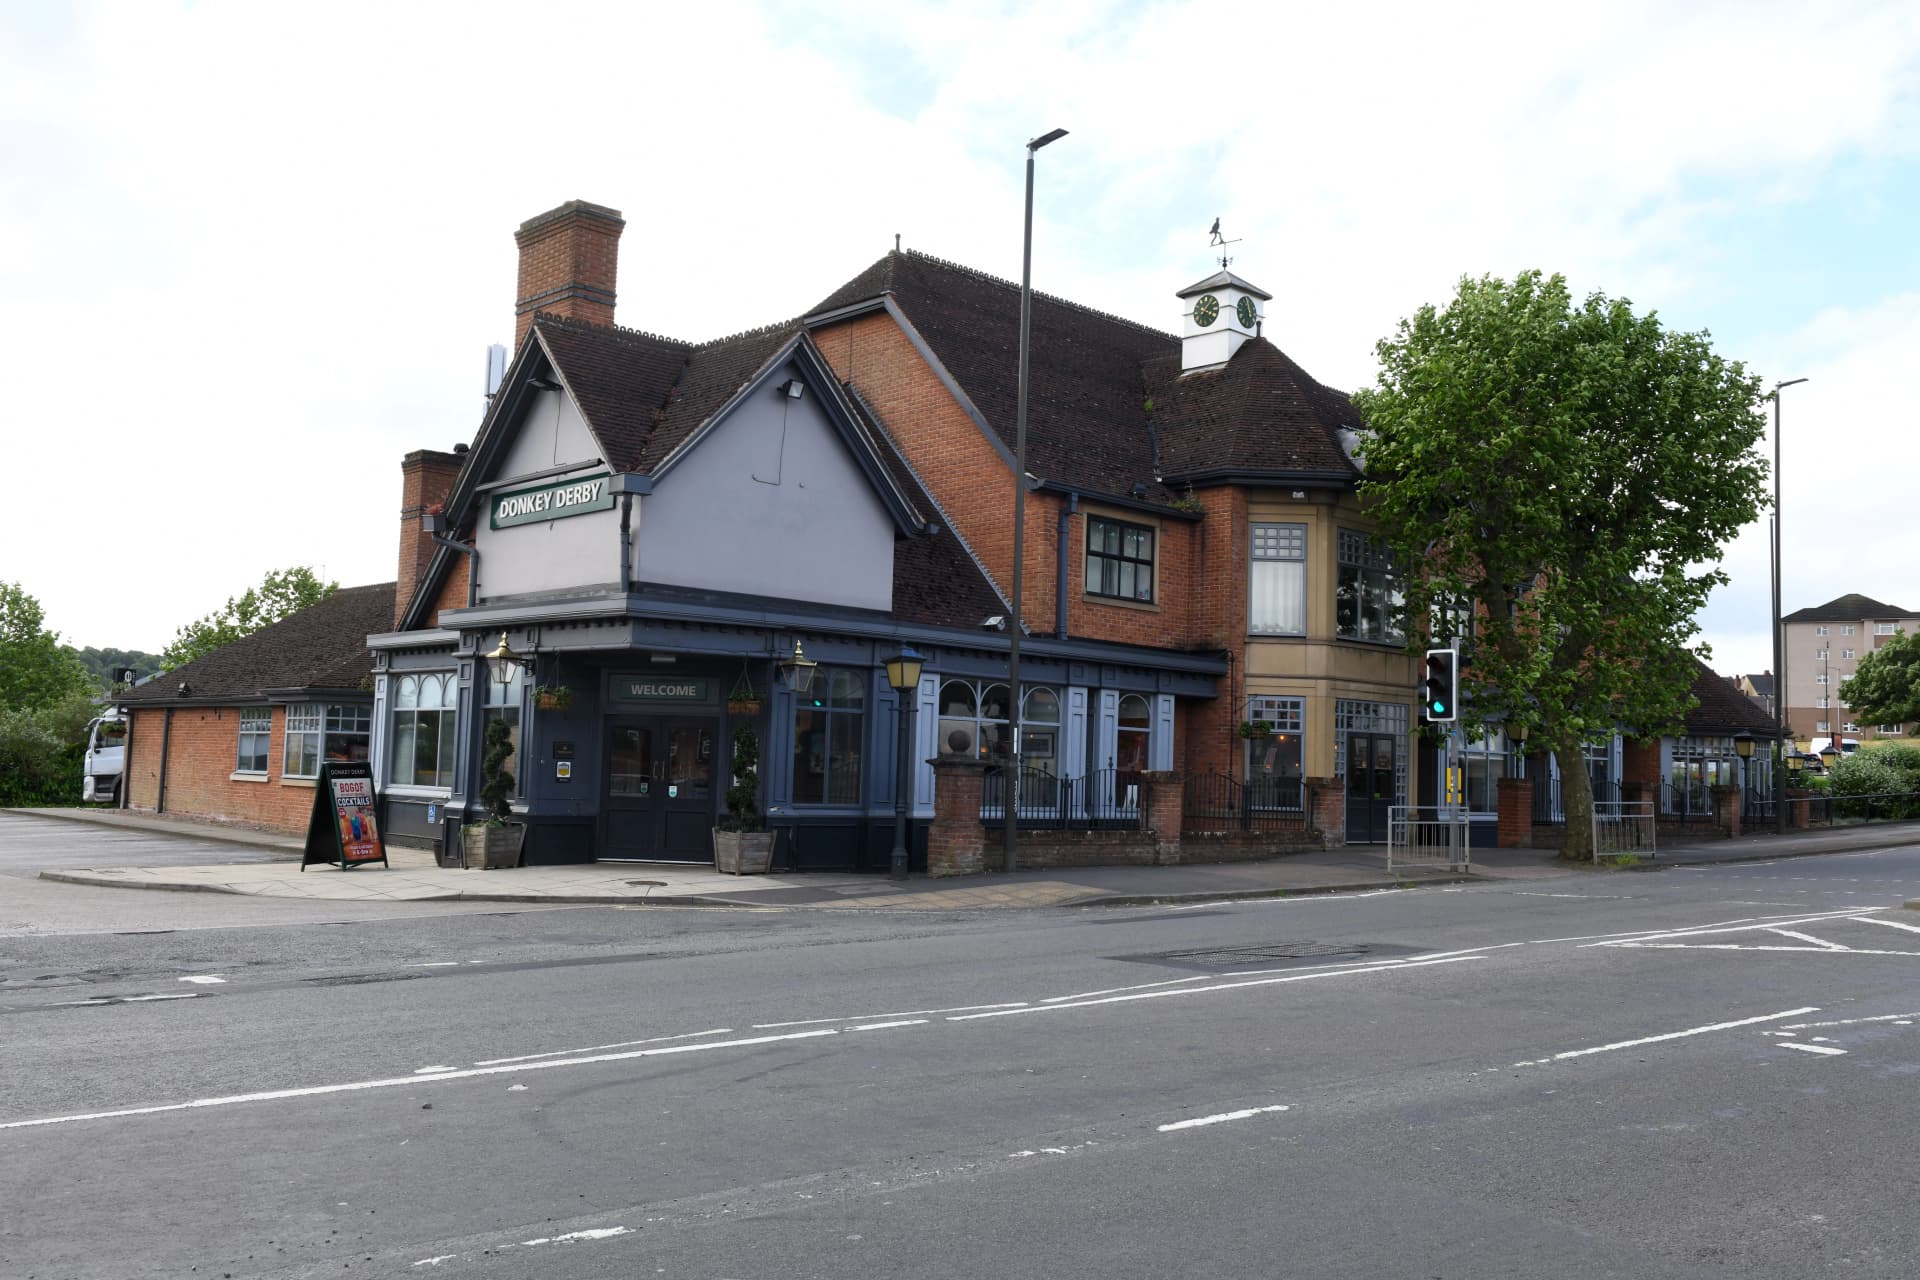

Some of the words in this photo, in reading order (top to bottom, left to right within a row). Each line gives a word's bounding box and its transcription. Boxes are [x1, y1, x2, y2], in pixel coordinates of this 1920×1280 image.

[499, 491, 553, 518] DONKEY
[556, 482, 602, 508] DERBY
[631, 684, 696, 696] WELCOME
[340, 783, 364, 793] BOGOF
[337, 797, 370, 806] COCKTAILS
